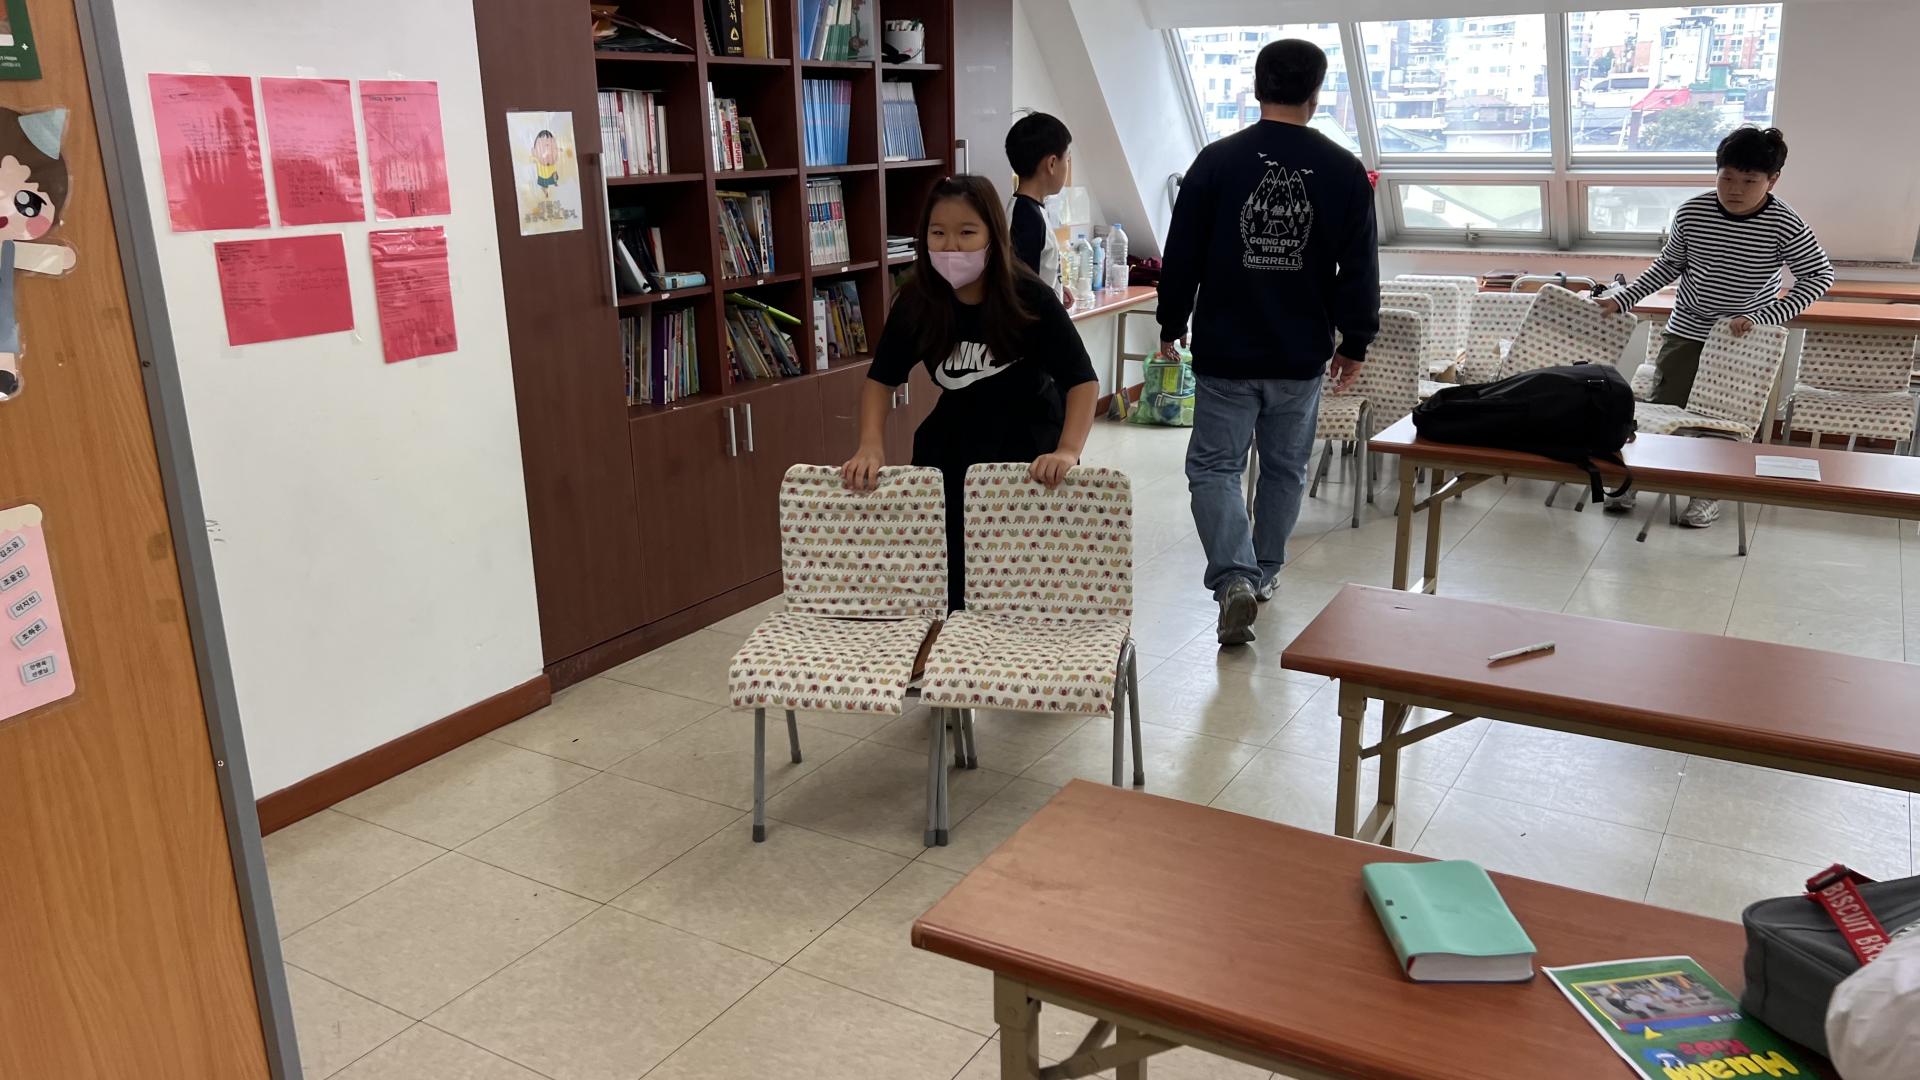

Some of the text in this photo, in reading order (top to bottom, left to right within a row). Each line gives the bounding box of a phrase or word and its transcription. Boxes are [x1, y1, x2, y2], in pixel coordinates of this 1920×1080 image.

[1249, 236, 1300, 247] GOING OUT
[1262, 246, 1285, 254] WITH
[1248, 255, 1299, 266] MERRELL
[1822, 881, 1876, 933] BISCUIT
